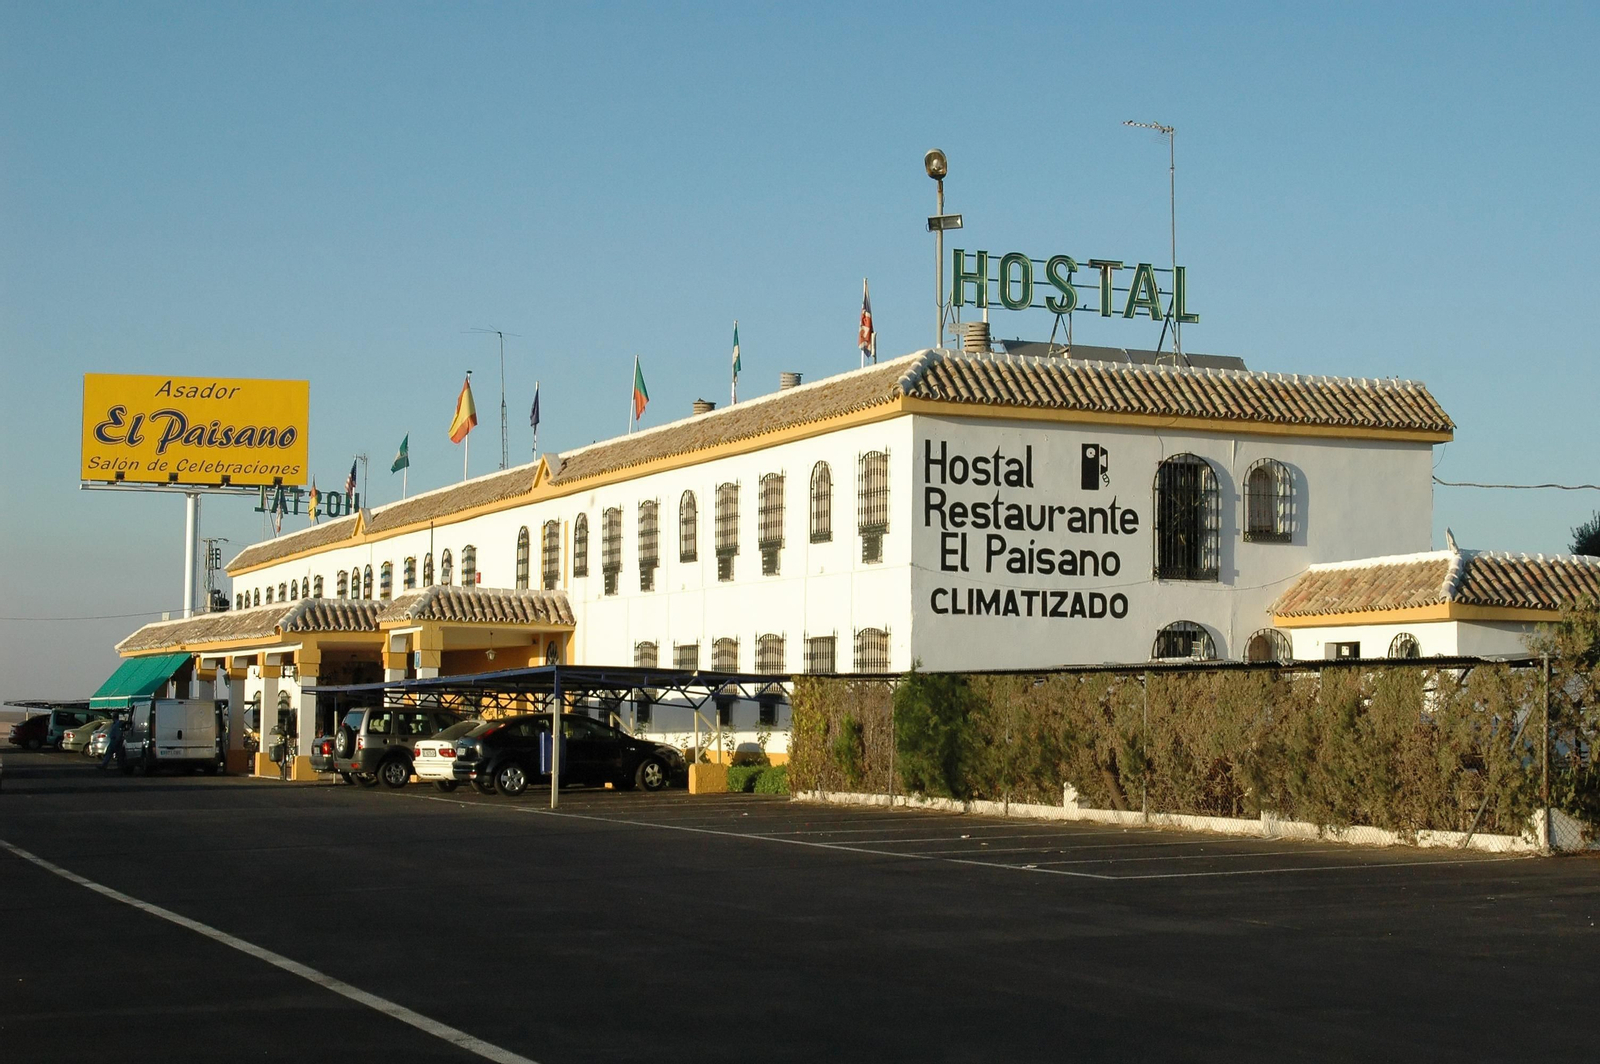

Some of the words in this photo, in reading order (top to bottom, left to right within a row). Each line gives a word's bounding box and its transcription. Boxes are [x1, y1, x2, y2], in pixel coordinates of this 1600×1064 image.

[952, 248, 1200, 324] HOSTAL
[154, 380, 241, 400] Asador
[93, 404, 145, 448] El
[149, 407, 298, 455] Paisano
[87, 456, 140, 471] Salón
[146, 458, 168, 471] de
[176, 458, 300, 475] Celebraciones
[924, 439, 1034, 489] Hostal
[924, 486, 1140, 535] Restaurante
[940, 531, 970, 573] El
[986, 533, 1121, 578] Paisano
[930, 587, 1129, 619] CLIMATIZADO
